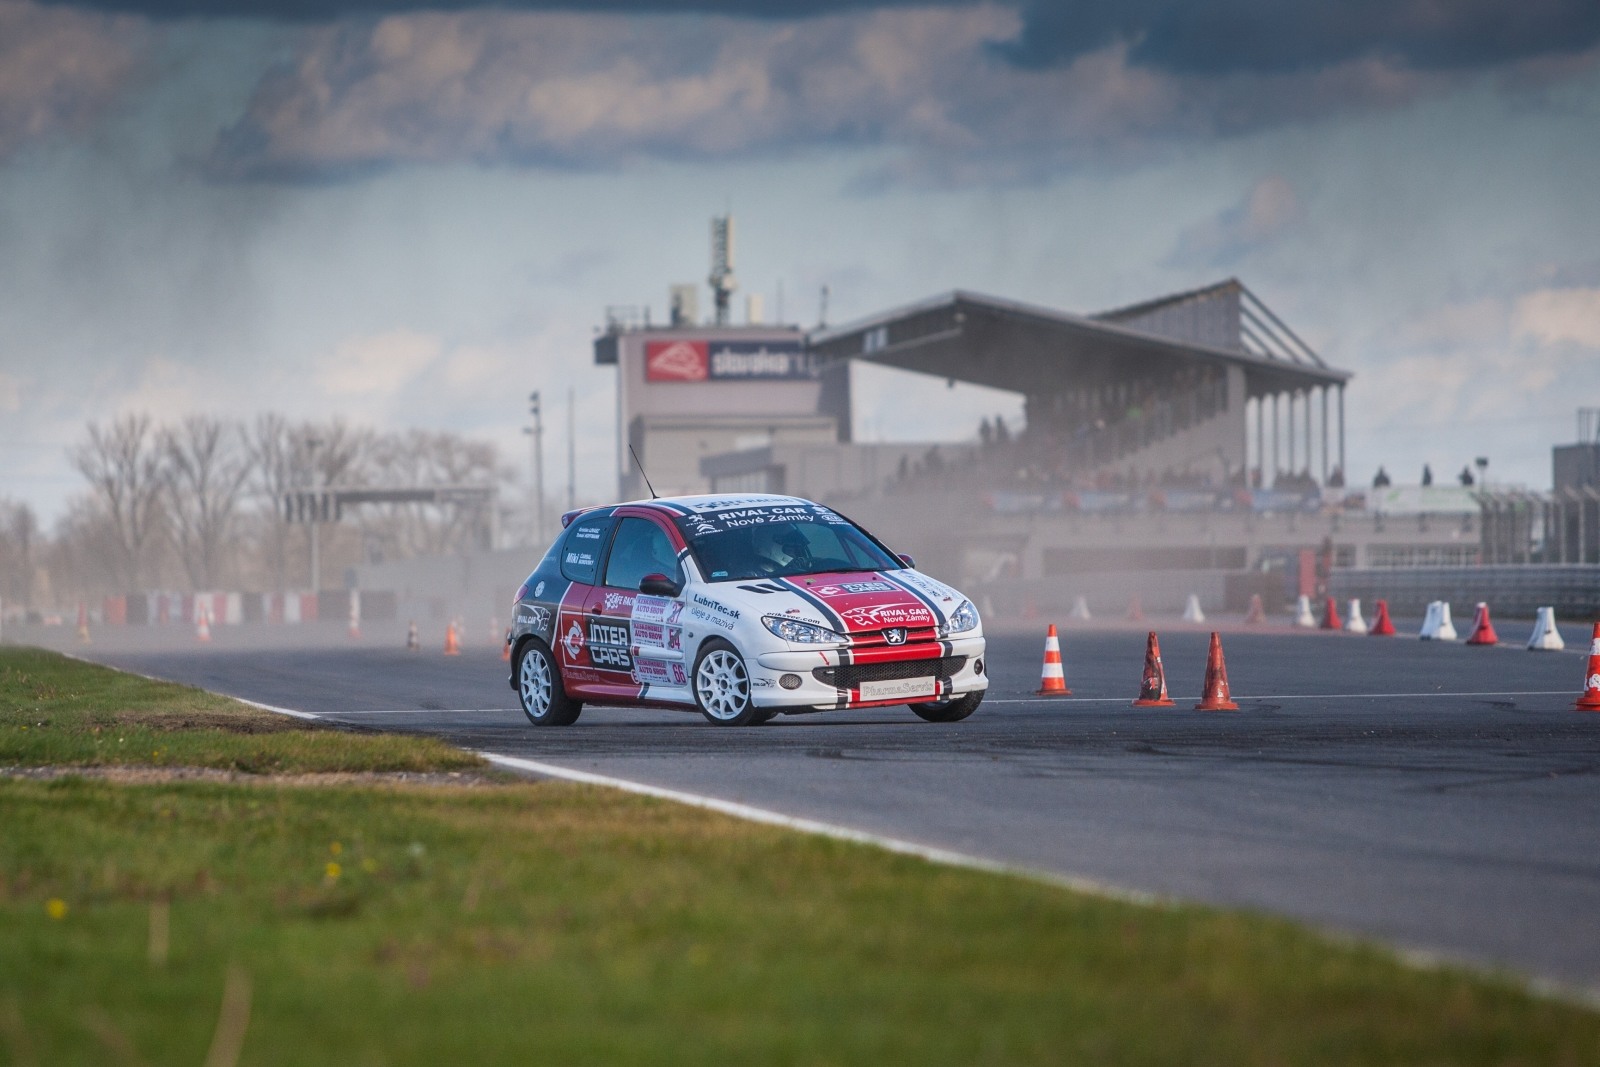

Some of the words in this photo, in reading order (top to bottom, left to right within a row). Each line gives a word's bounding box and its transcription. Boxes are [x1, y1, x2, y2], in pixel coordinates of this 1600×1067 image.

[718, 508, 769, 520] RIVAL
[771, 507, 807, 515] CAR
[726, 515, 765, 528] Nové
[768, 513, 814, 523] Zámky
[636, 605, 650, 613] AUTO
[650, 606, 664, 615] SHOW
[693, 593, 741, 619] LubriTec.sk
[880, 609, 908, 617] RIVAL
[909, 608, 928, 616] CAR
[528, 616, 537, 625] CAR
[691, 607, 705, 619] oleje
[710, 616, 736, 631] mazivá
[883, 616, 904, 624] Nové
[905, 614, 930, 623] Zámky
[635, 630, 648, 638] AUTO
[648, 631, 663, 640] SHOW
[590, 646, 631, 667] CARS
[639, 666, 653, 674] AUTO
[653, 667, 668, 676] SHOW
[672, 663, 687, 684] 66
[862, 681, 934, 697] PharmaServis
